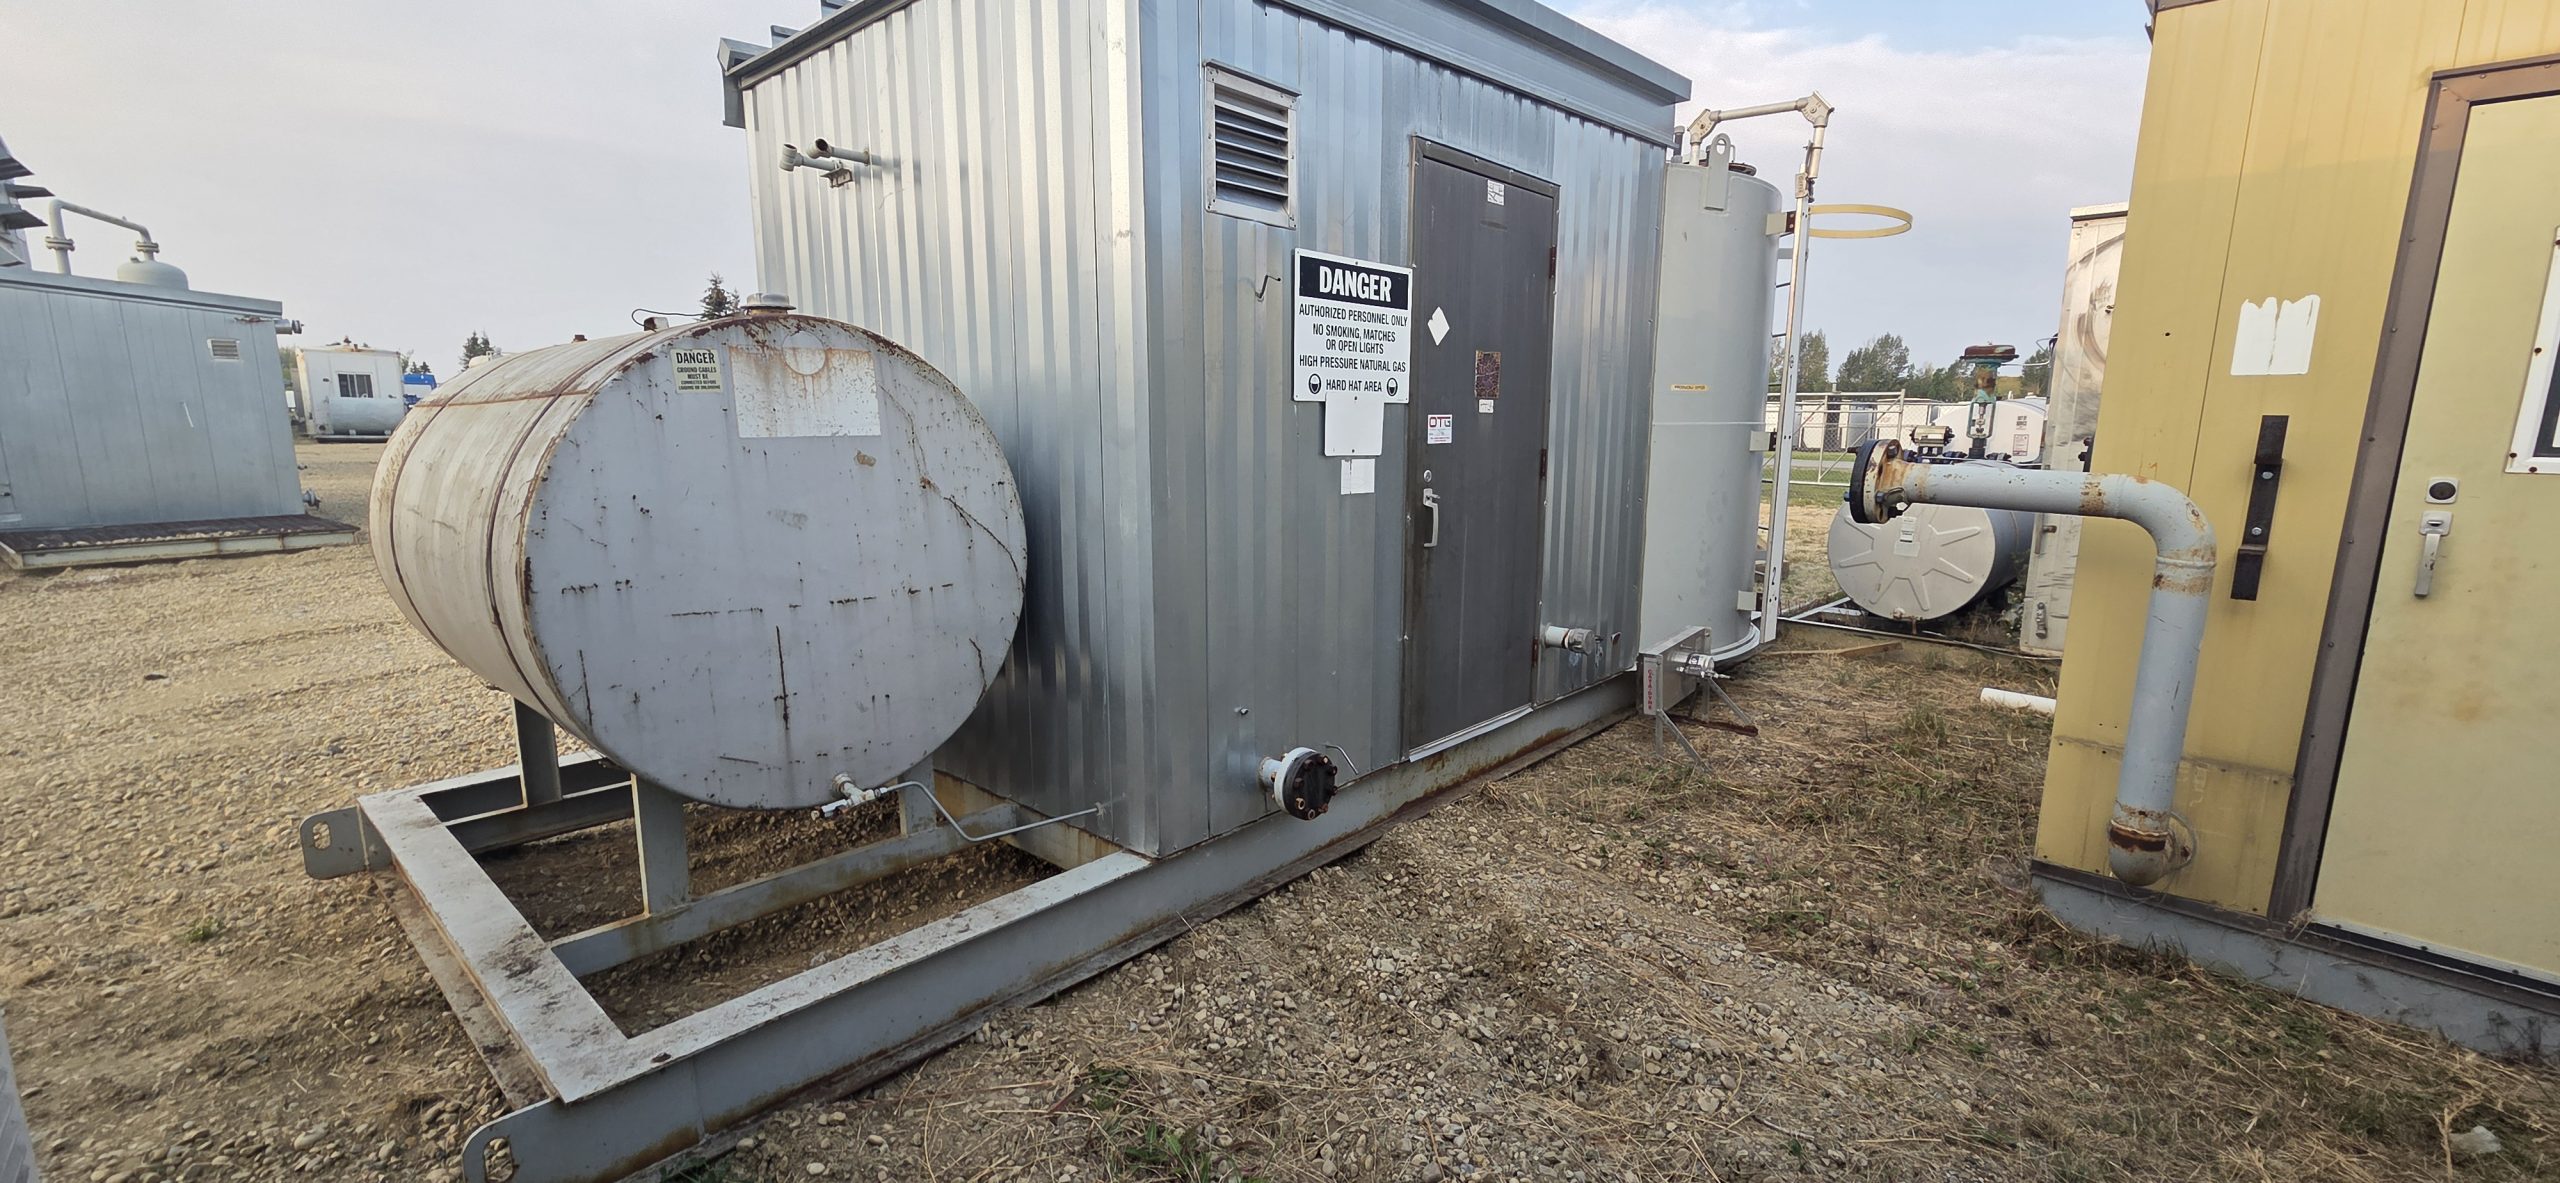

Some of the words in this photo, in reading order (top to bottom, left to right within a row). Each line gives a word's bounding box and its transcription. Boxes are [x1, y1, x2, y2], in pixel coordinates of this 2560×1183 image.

[1319, 265, 1392, 302] DANGER
[1299, 303, 1347, 320] AUTHORIZED
[1348, 309, 1389, 325] PERSONNEL
[1391, 315, 1408, 327] ONLY
[1313, 323, 1324, 335] NO
[1326, 324, 1361, 341] SMOKING,
[1363, 329, 1396, 342] MATCHES
[1325, 339, 1336, 350] OR
[1338, 340, 1358, 353] OPEN
[1359, 342, 1384, 354] LIGHTS
[676, 352, 716, 364] DANGER
[1299, 355, 1318, 367] HIGH
[1320, 356, 1358, 369] PRESSURE
[1360, 359, 1391, 372] NATURAL
[1393, 361, 1406, 372] GAS
[1325, 379, 1347, 391] HARD
[1348, 380, 1362, 391] HAT
[1363, 381, 1383, 392] AREA
[1429, 416, 1451, 428] OTG
